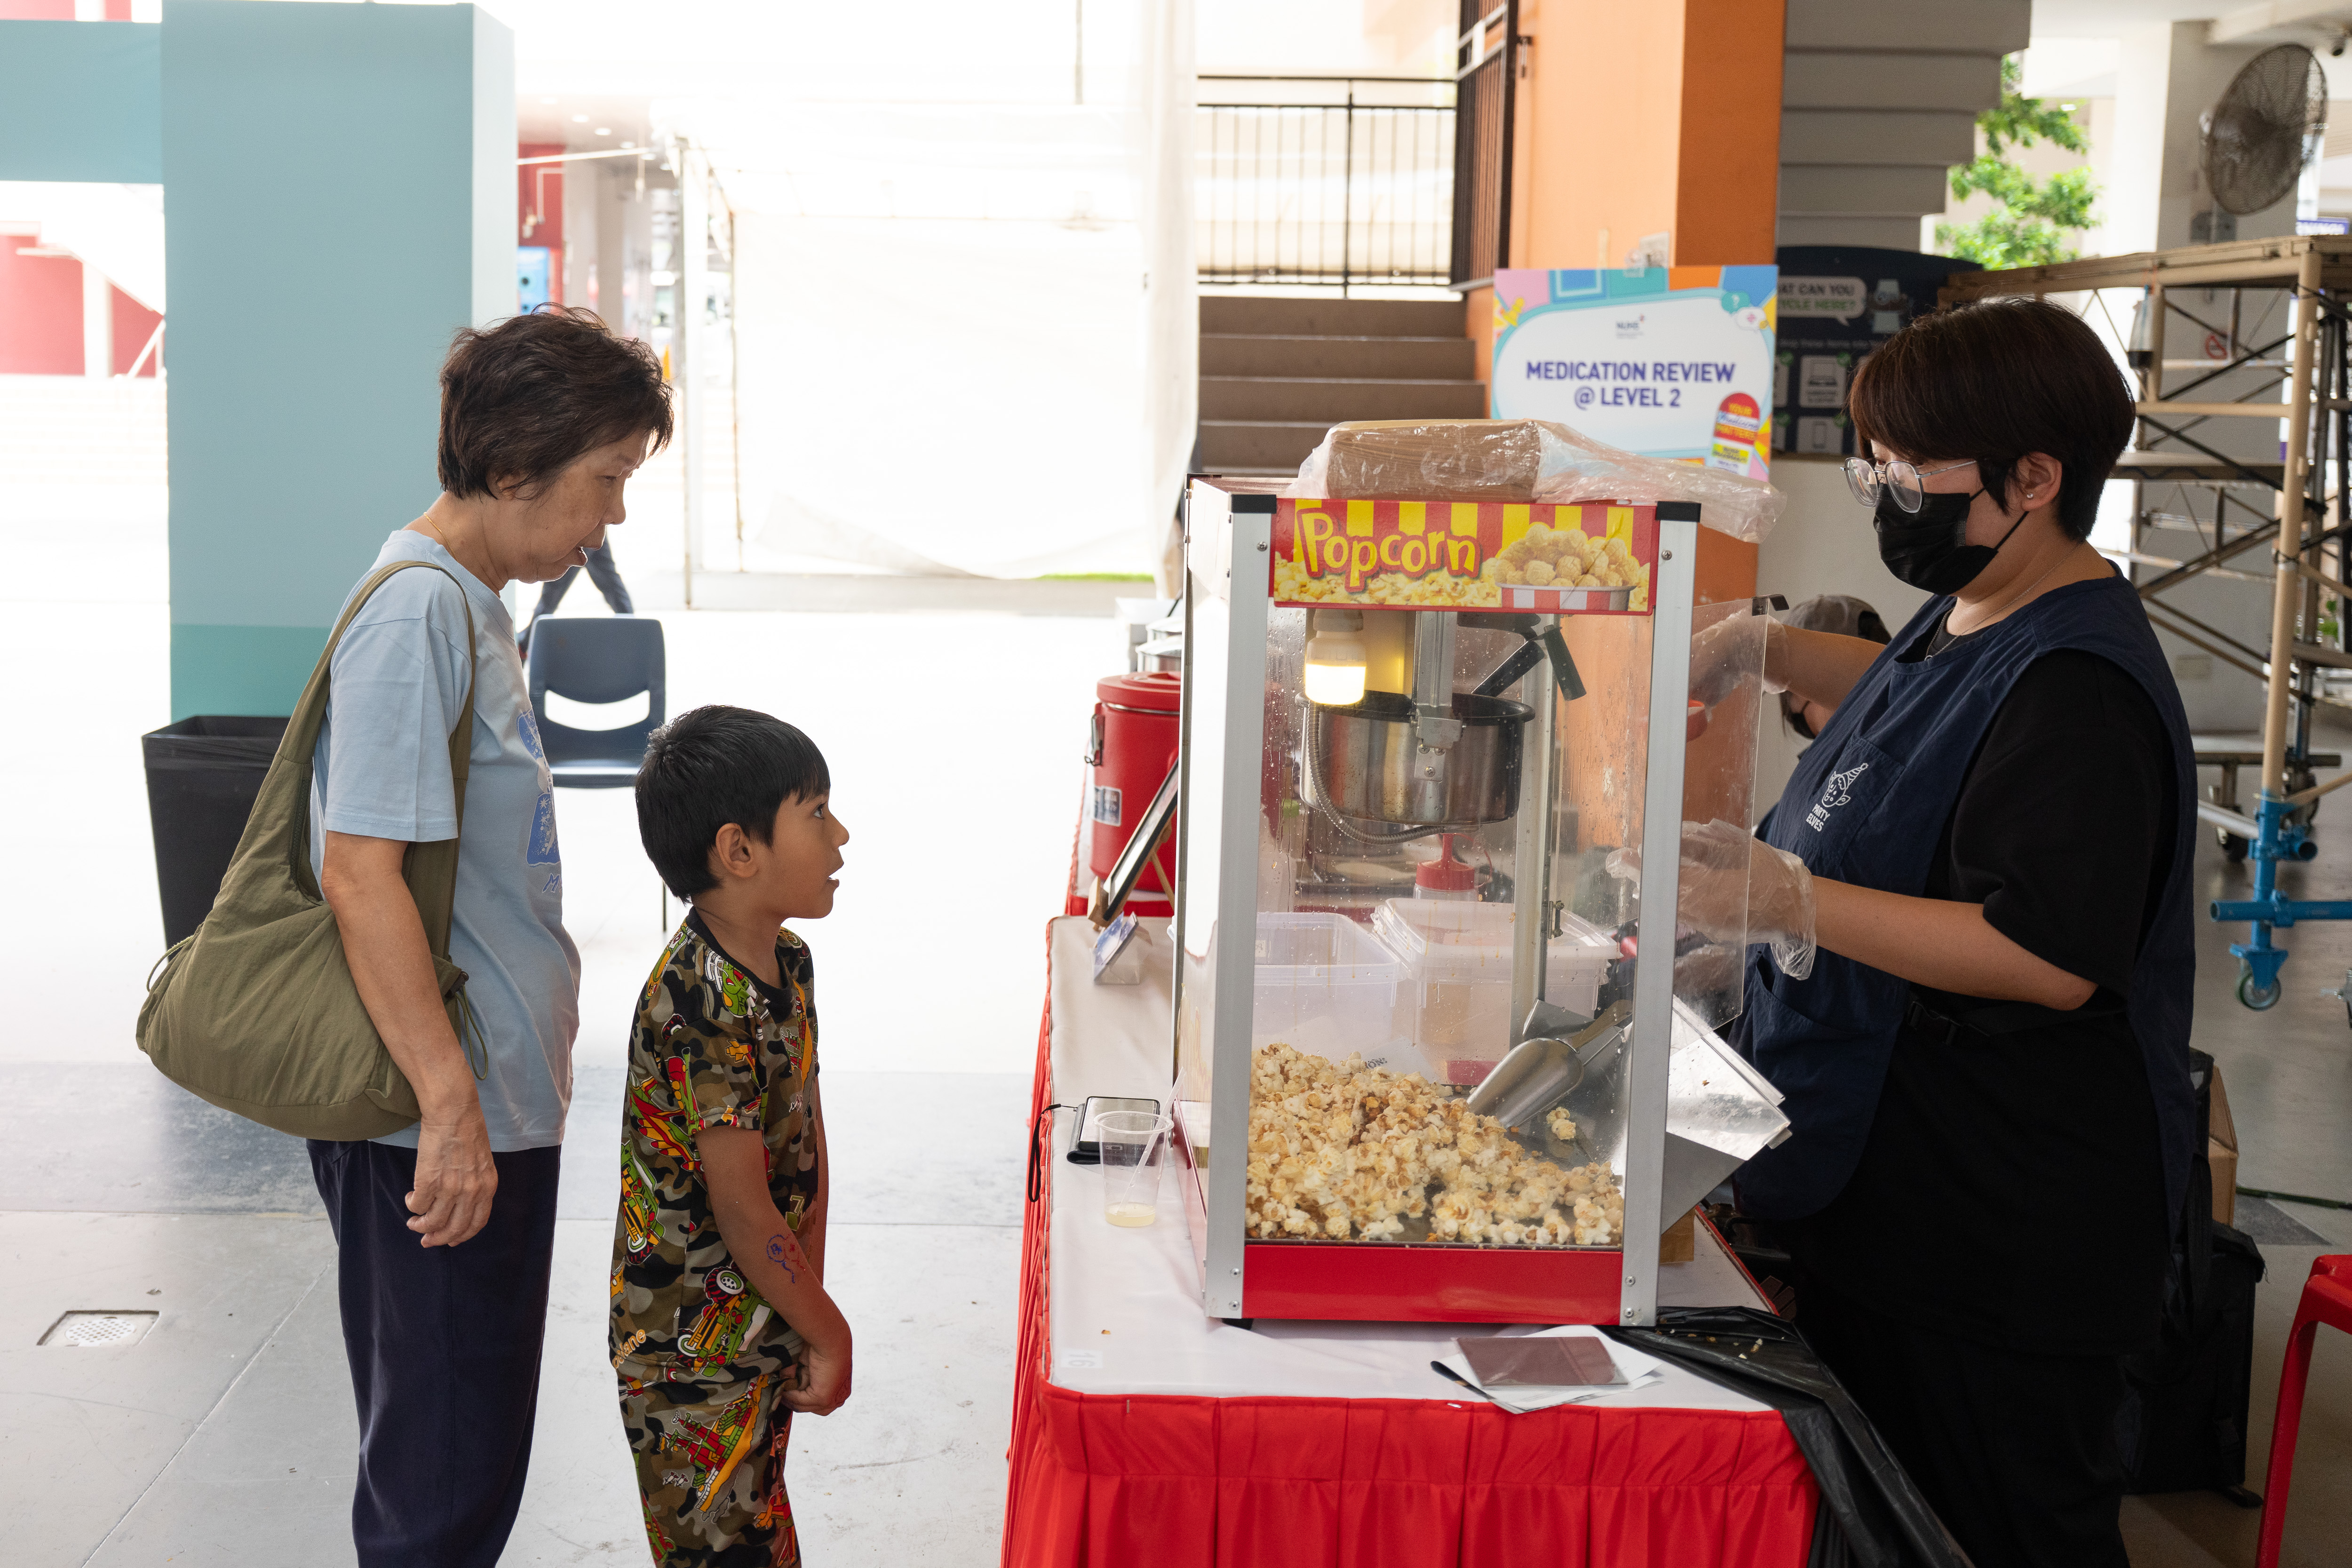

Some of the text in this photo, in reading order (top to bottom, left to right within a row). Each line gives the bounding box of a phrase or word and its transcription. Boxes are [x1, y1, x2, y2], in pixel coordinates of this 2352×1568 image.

[1798, 283, 1825, 295] CAN
[1829, 283, 1855, 296] YOU
[1526, 361, 1736, 382] MEDICATION REVIEW
[1574, 386, 1680, 411] @ LEVEL 2
[1728, 402, 1753, 417] YOUR
[1297, 509, 1480, 591] Popcorn
[1806, 812, 1824, 832] ELVES
[1812, 803, 1831, 821] PARTY
